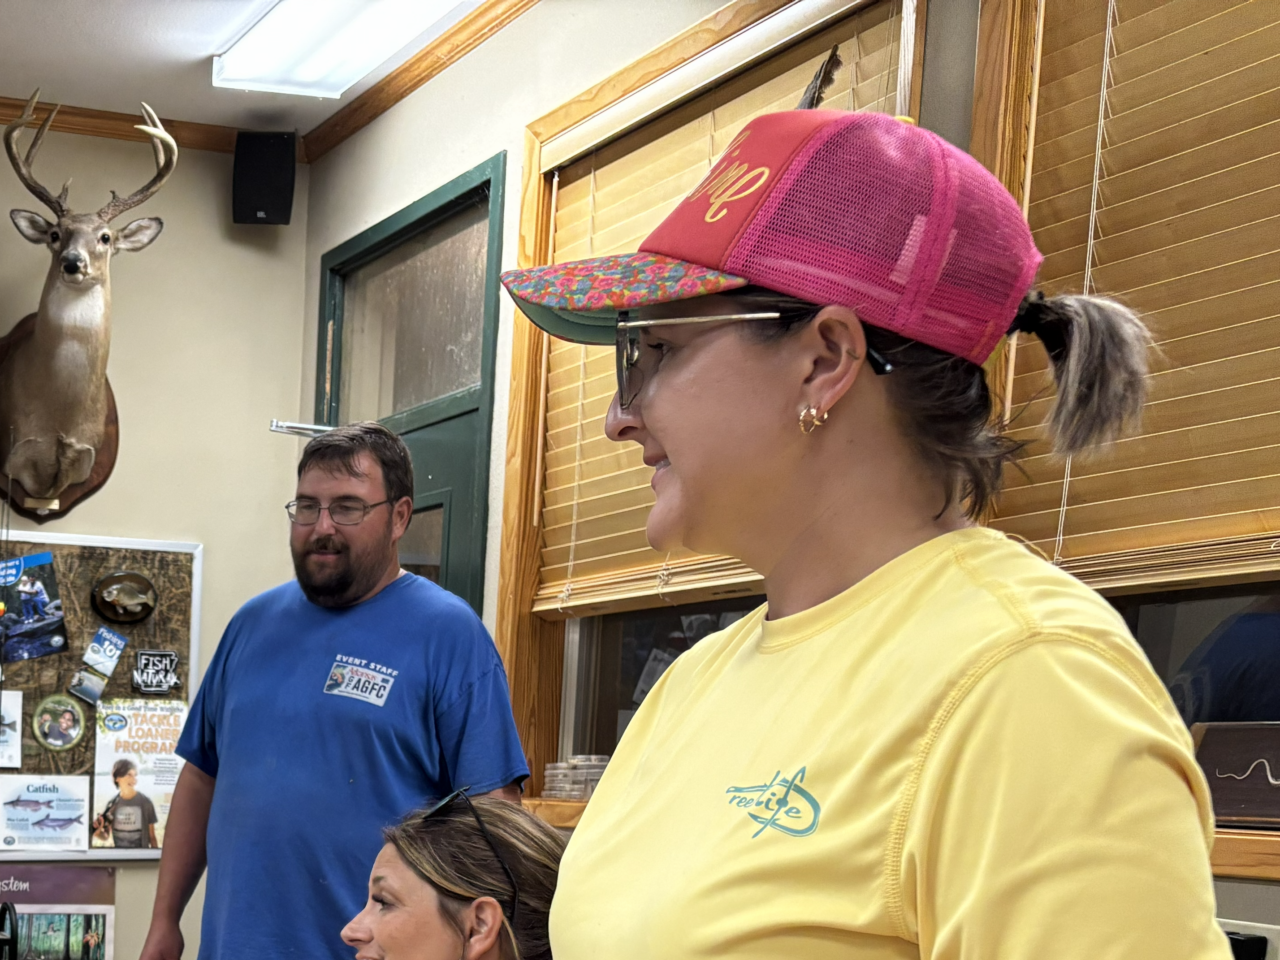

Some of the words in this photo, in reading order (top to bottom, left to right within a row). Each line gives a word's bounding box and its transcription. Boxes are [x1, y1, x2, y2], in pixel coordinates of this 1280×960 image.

[98, 627, 126, 650] Fishing
[103, 640, 122, 660] 101
[141, 655, 171, 670] FISH
[335, 654, 368, 667] EVENT
[368, 662, 399, 678] STAFF
[351, 677, 387, 700] AGFC
[132, 712, 181, 727] TACKLE
[128, 727, 180, 740] LOANER
[26, 784, 59, 794] Catfish
